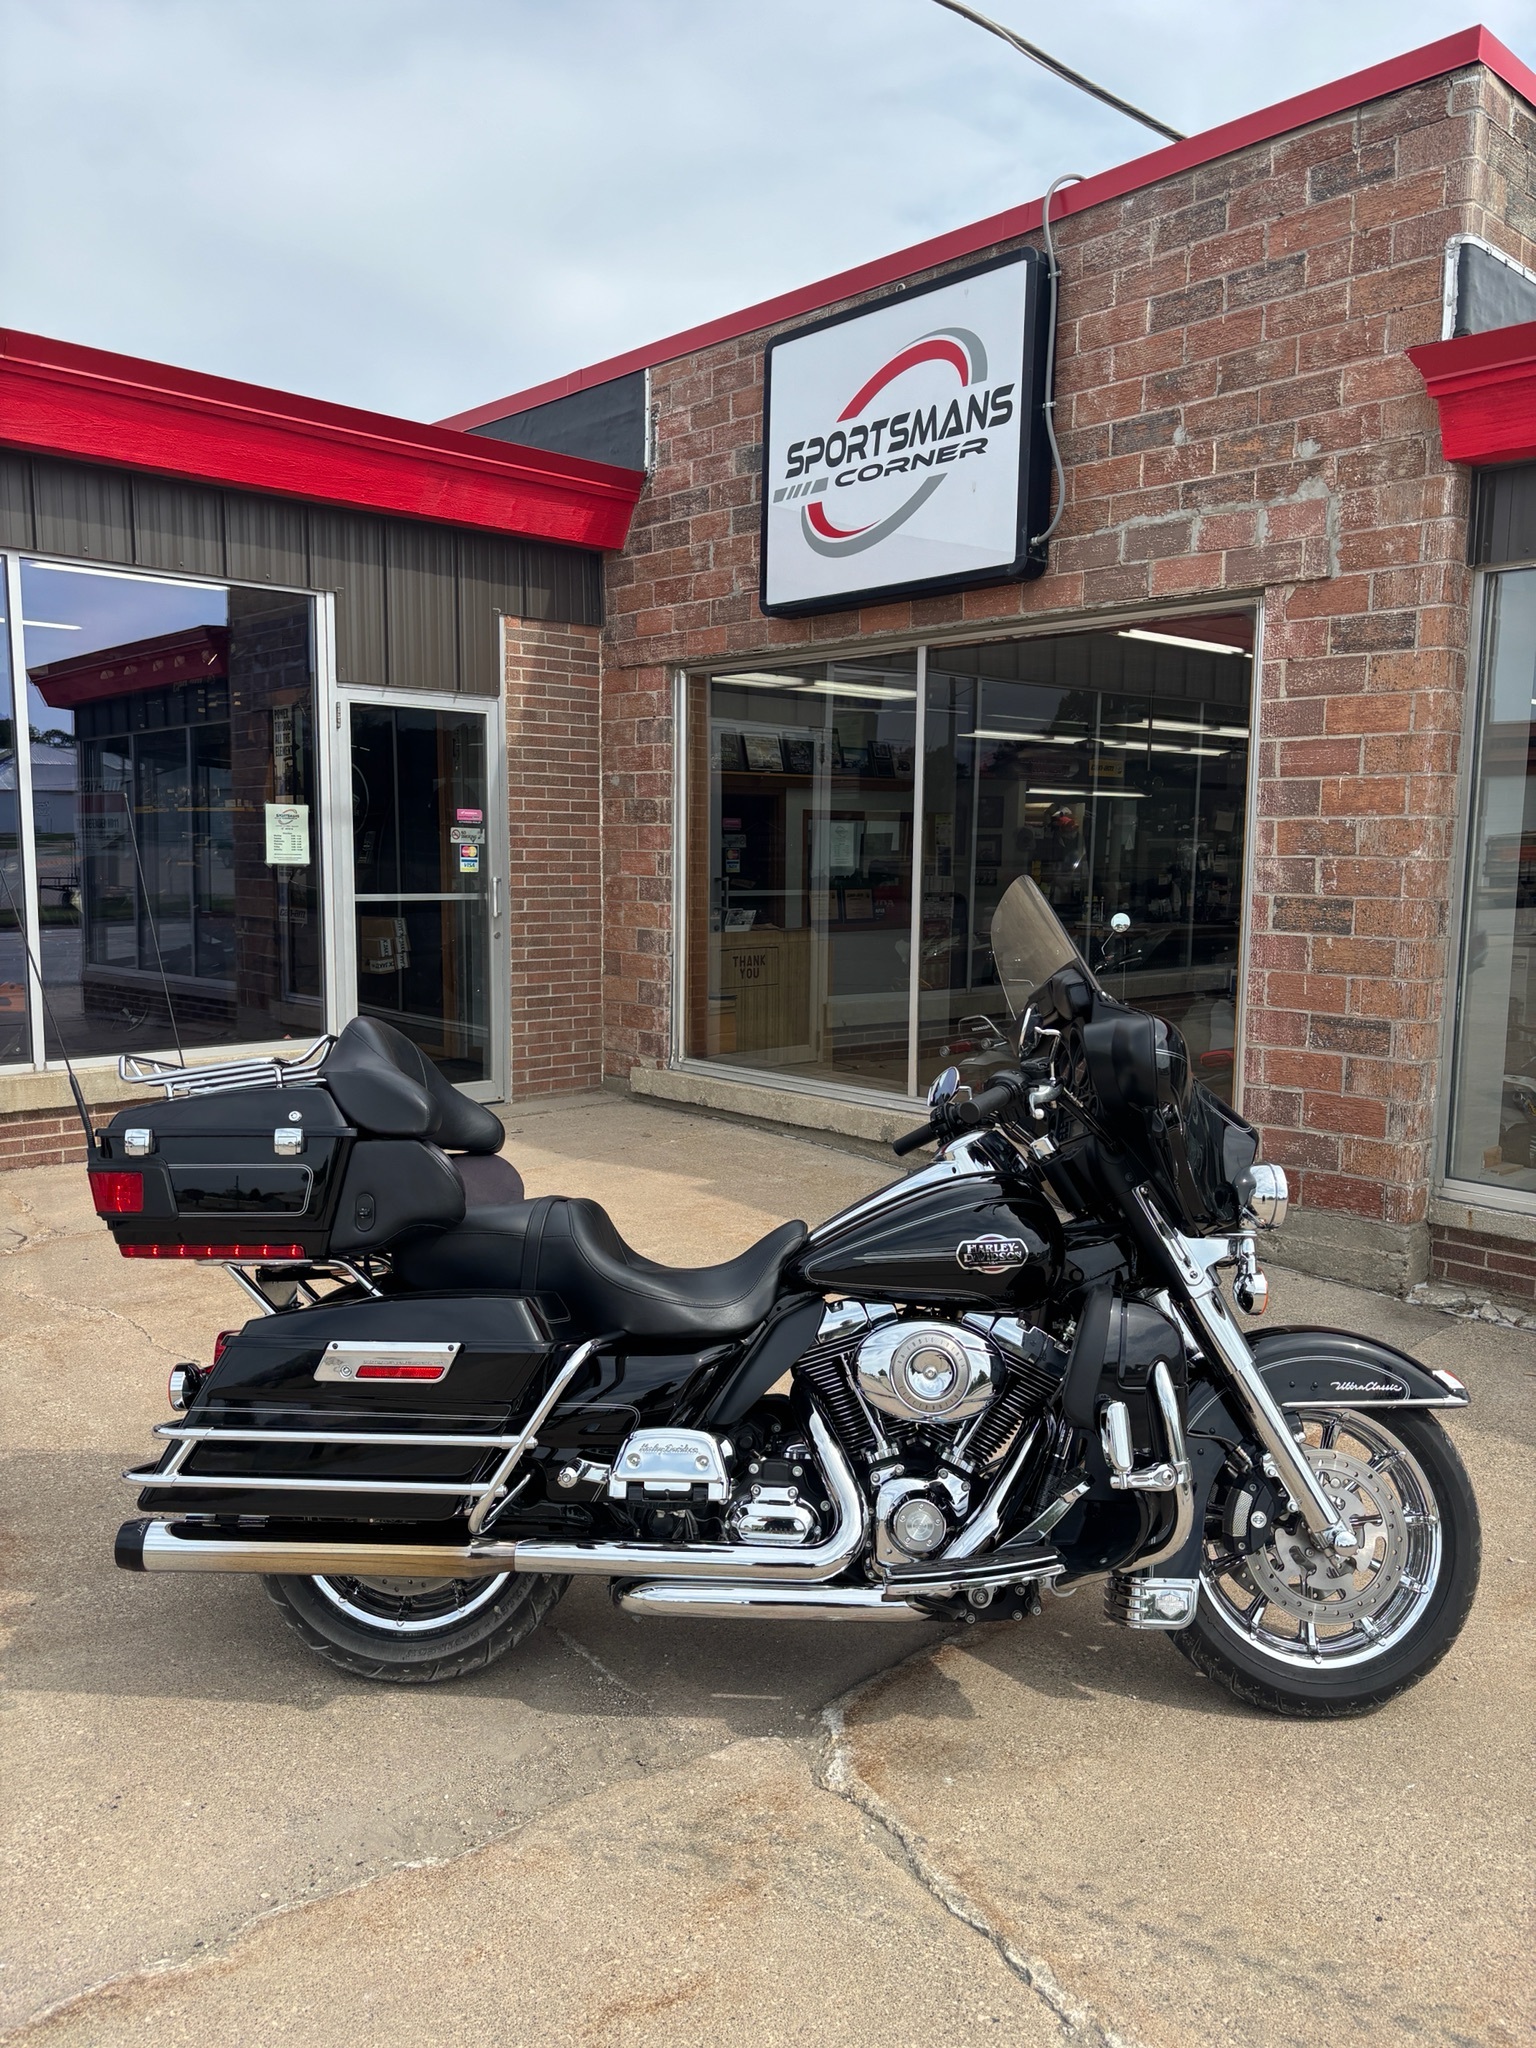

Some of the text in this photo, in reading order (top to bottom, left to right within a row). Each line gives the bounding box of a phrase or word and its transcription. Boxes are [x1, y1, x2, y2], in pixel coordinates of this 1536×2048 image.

[785, 383, 1015, 479] SPORTSMANS
[834, 437, 988, 487] CORNER
[732, 954, 766, 967] THANK
[740, 967, 760, 979] YOU
[967, 1243, 1019, 1254] HARLEY-
[963, 1251, 1022, 1263] DAVIDSON
